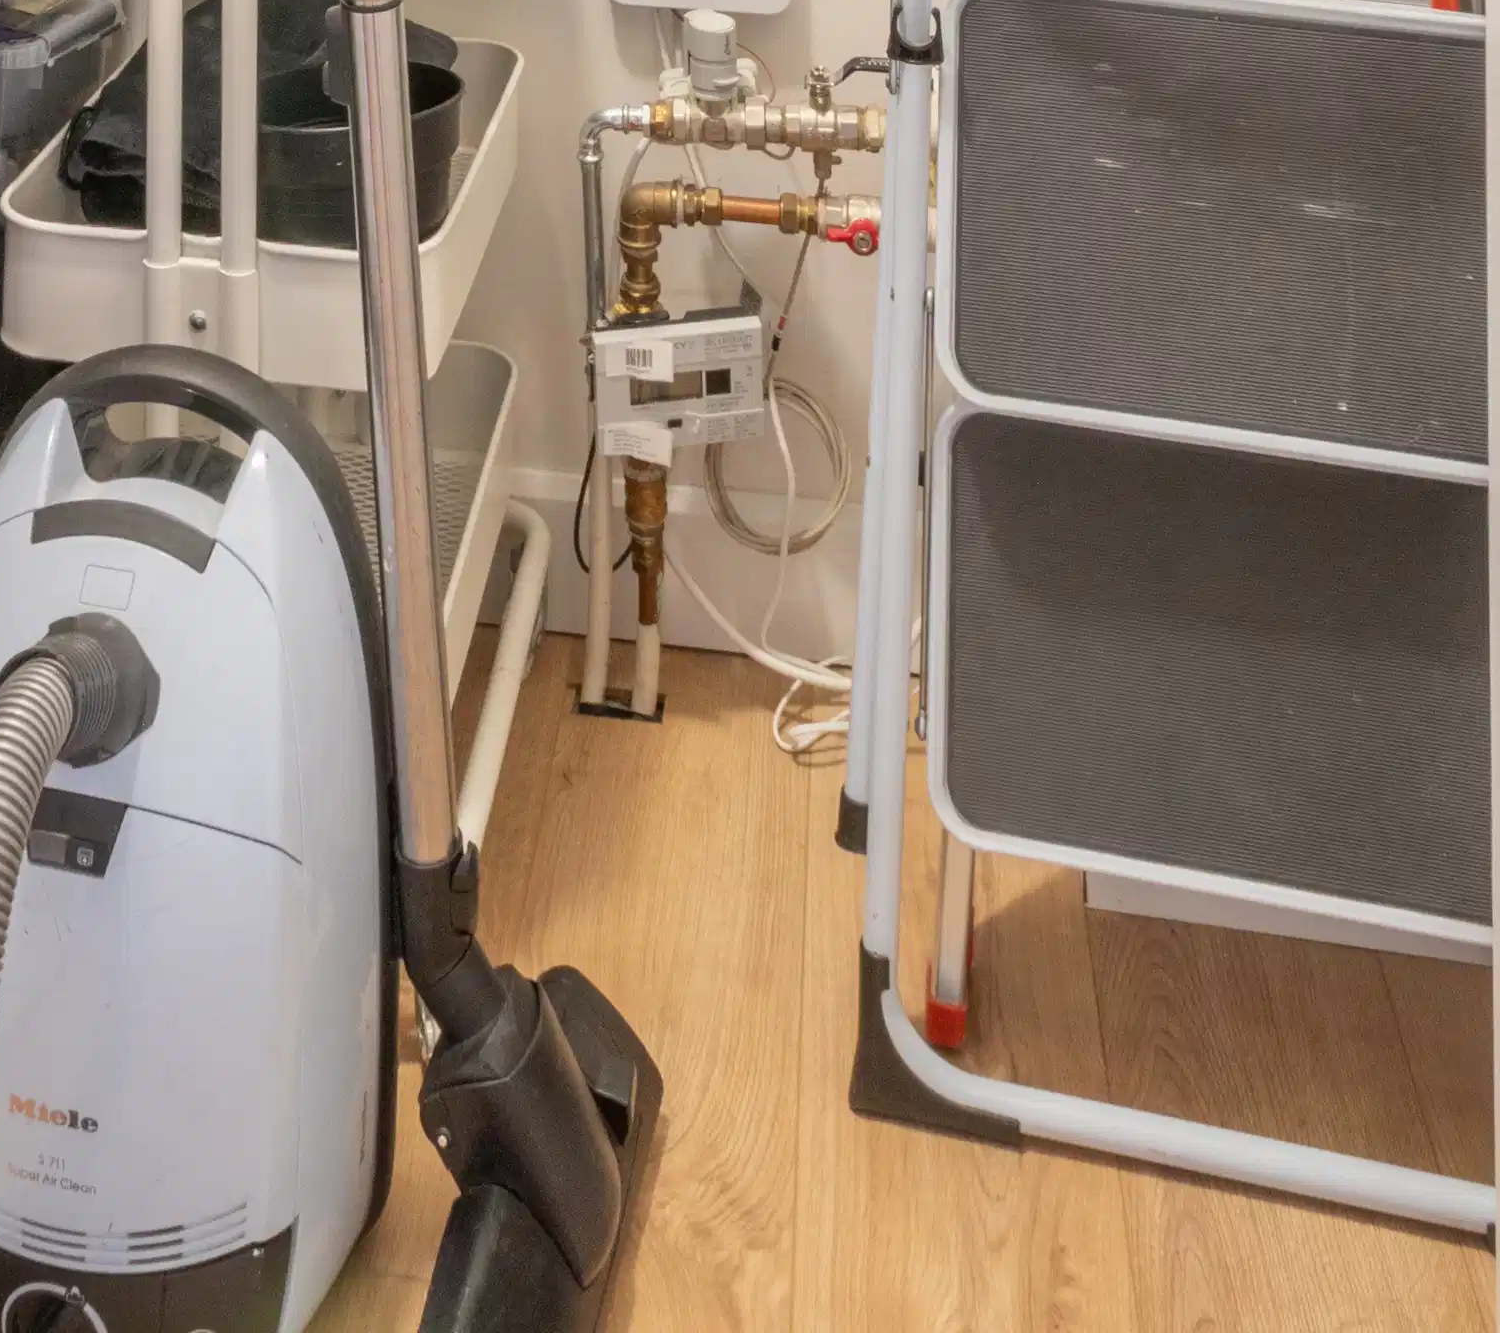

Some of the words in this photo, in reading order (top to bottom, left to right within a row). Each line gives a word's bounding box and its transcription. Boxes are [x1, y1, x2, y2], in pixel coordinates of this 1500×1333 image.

[9, 1093, 99, 1133] Miele
[42, 1173, 58, 1188] Air
[60, 1178, 97, 1195] Clean
